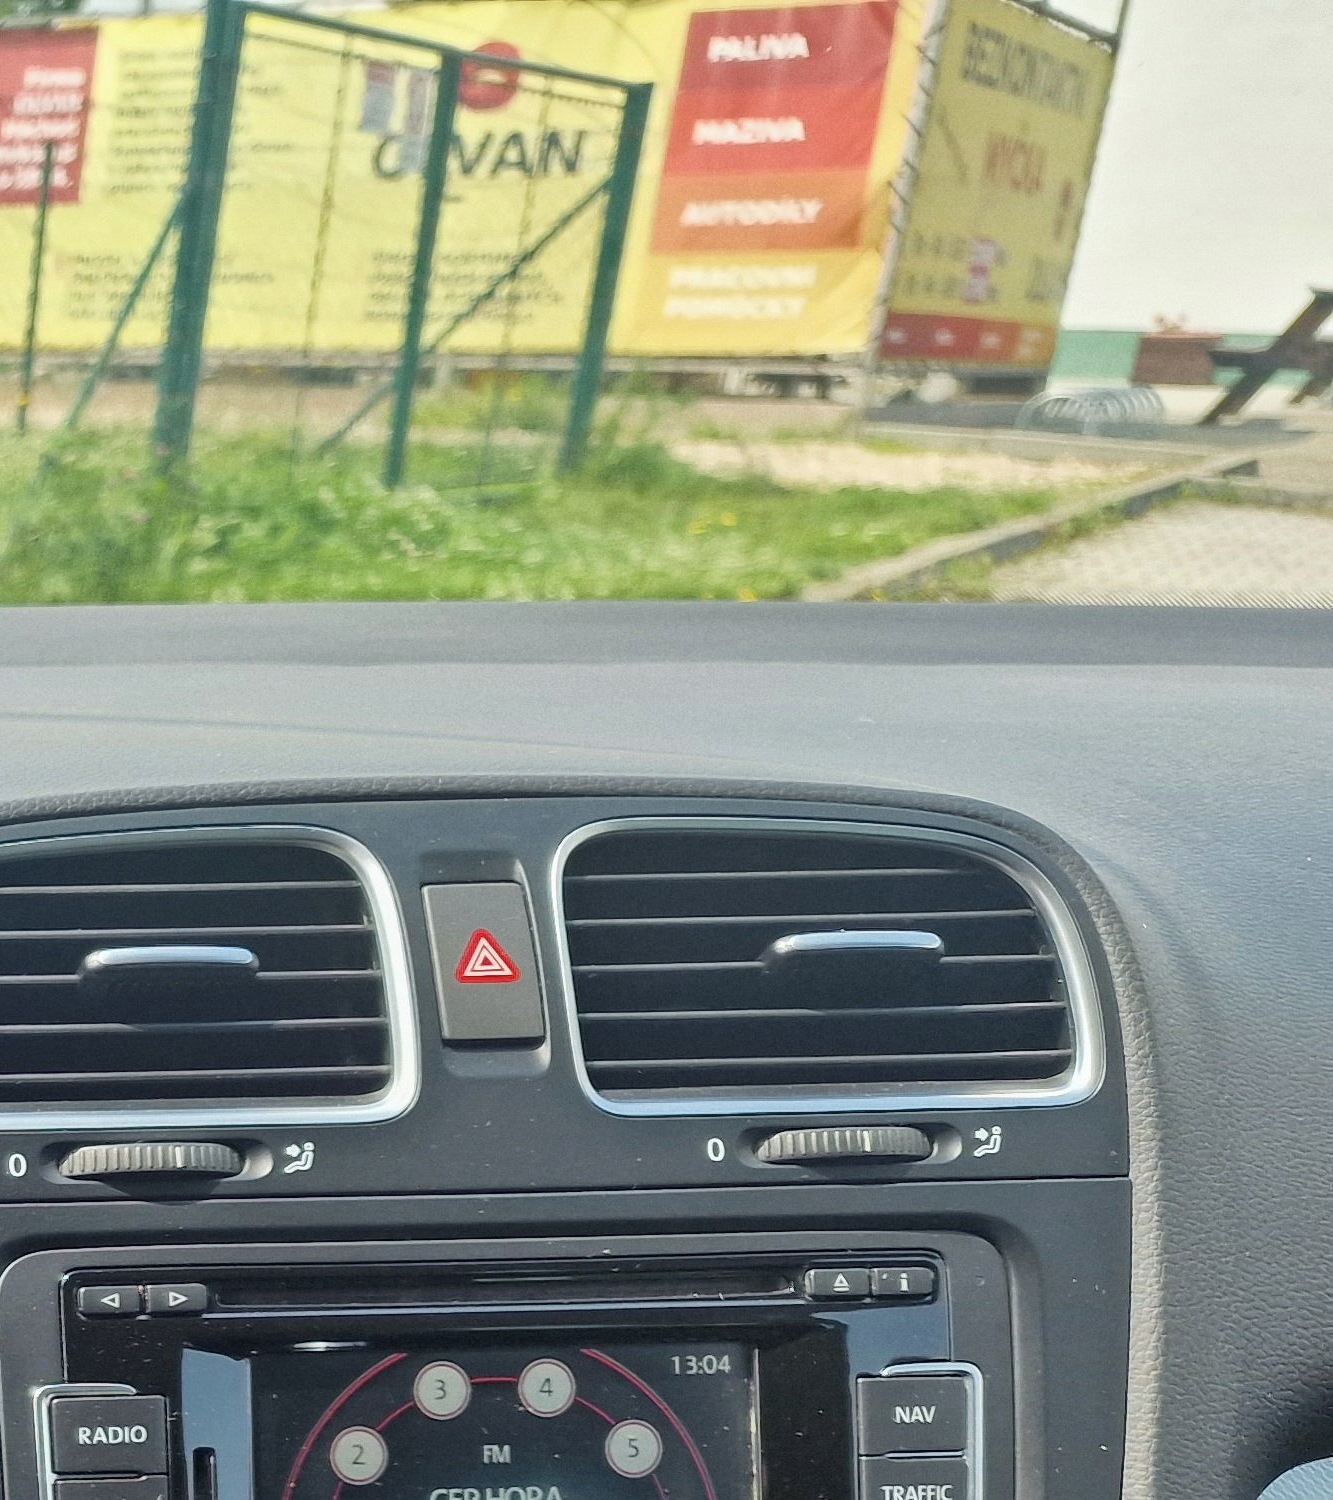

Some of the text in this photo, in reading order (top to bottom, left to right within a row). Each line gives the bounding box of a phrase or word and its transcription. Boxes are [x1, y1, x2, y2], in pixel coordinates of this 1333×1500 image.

[670, 1353, 731, 1376] 13:04
[434, 1380, 447, 1400] 3
[539, 1377, 552, 1397] 4
[893, 1406, 936, 1425] NAV
[77, 1424, 148, 1446] RADIO
[351, 1445, 366, 1466] 2
[483, 1444, 512, 1464] FM
[627, 1438, 639, 1459] 5
